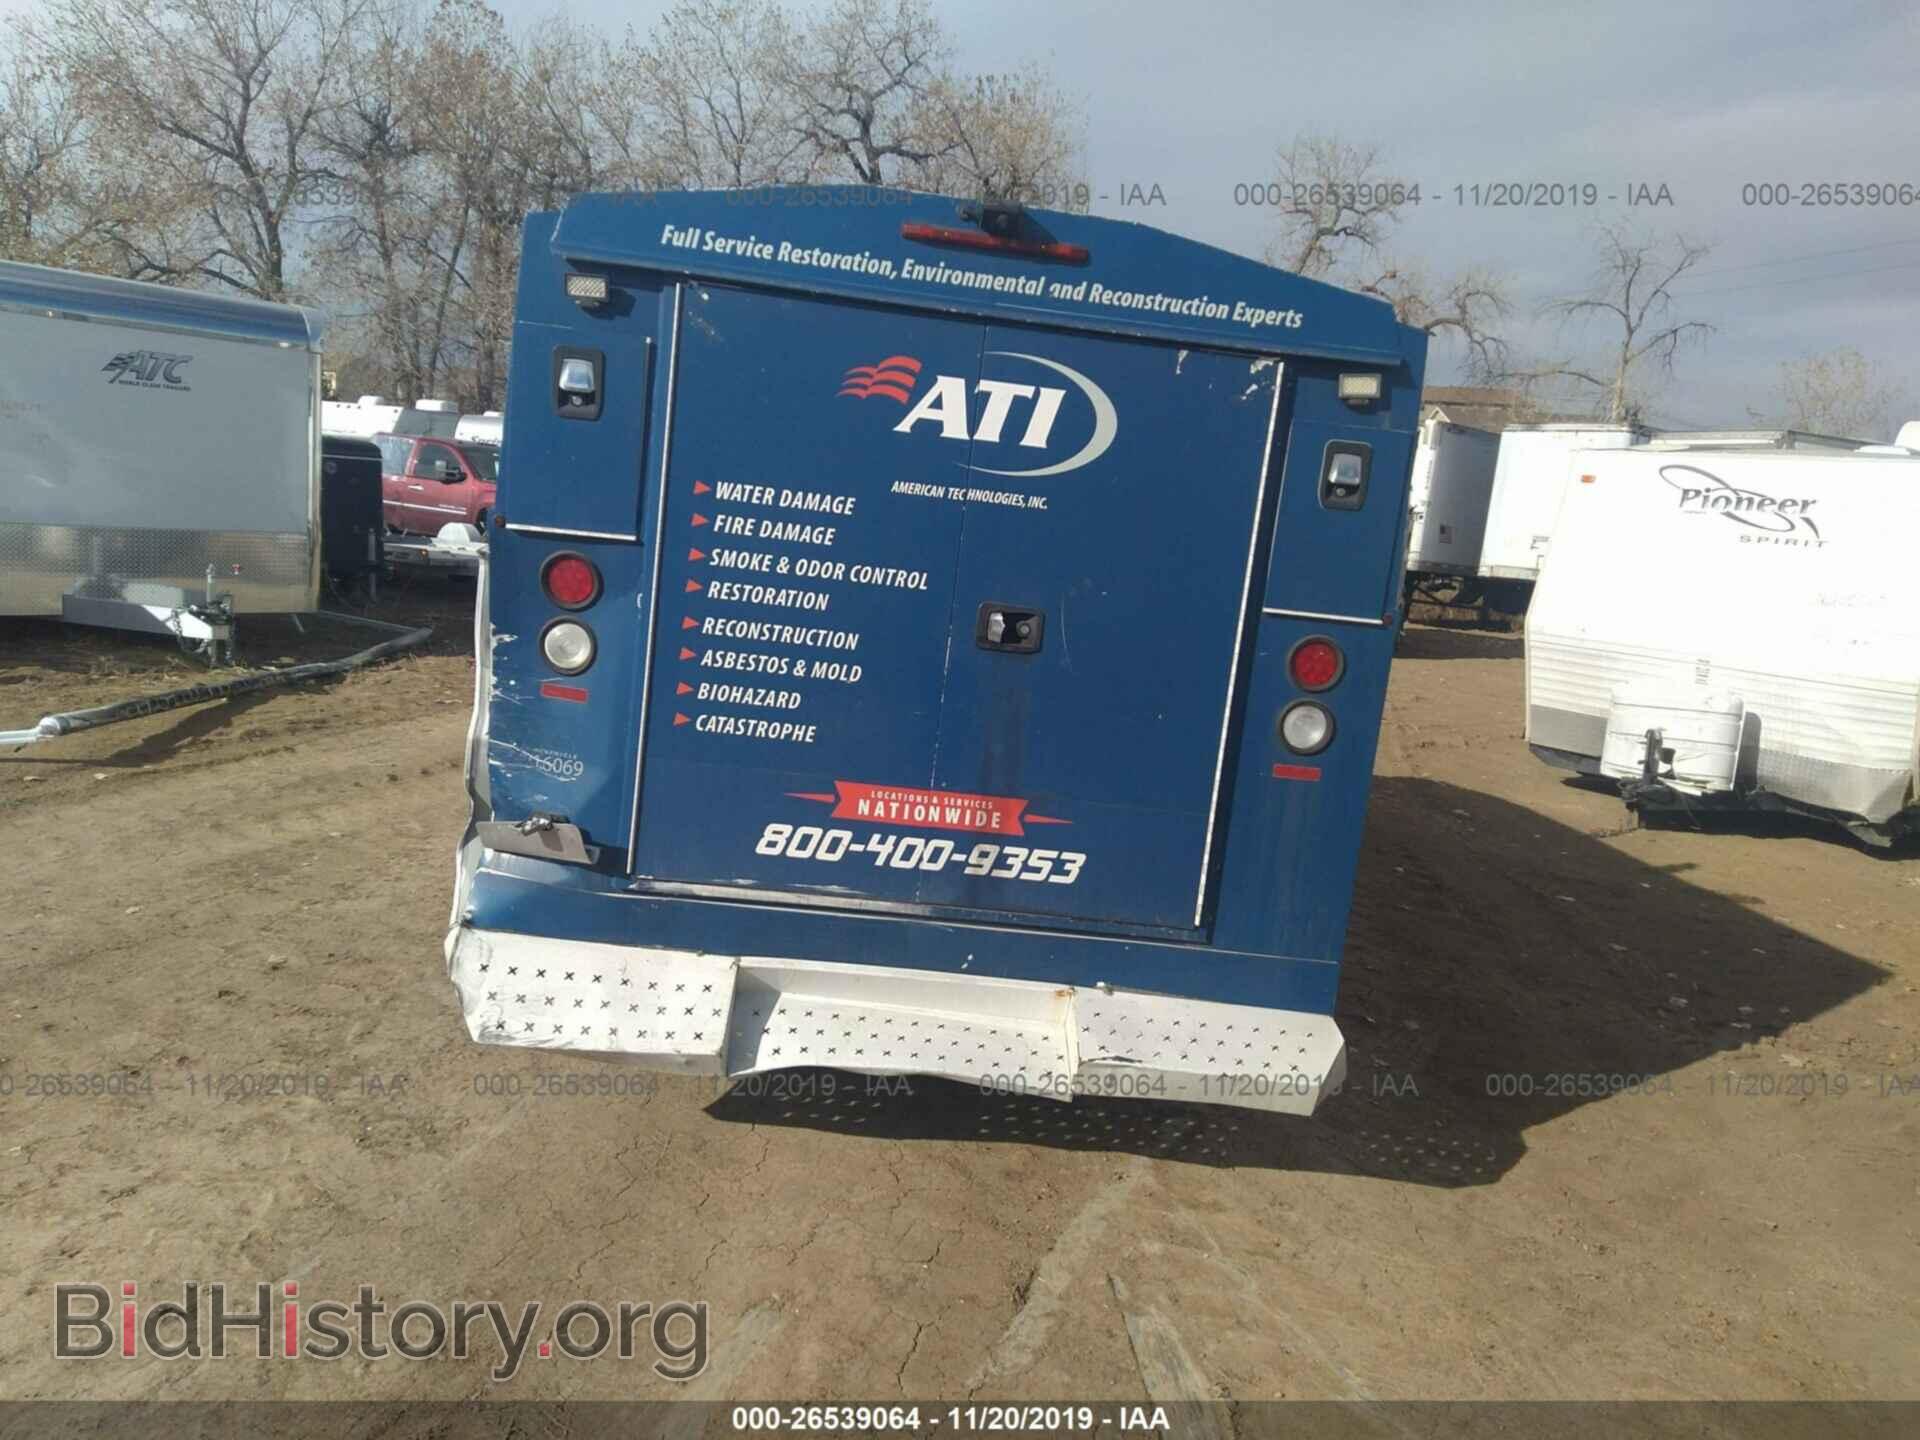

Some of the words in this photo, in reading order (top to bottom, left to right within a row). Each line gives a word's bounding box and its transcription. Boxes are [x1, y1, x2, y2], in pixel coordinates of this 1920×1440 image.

[661, 224, 701, 250] Full
[702, 230, 774, 261] Service
[777, 241, 898, 280] Restoration,
[901, 258, 1046, 297] Environmental
[1049, 281, 1088, 302] and
[1089, 284, 1229, 321] Reconstruction
[1232, 302, 1304, 328] Experts
[108, 350, 194, 384] ATC
[892, 375, 1067, 449] ATI
[715, 481, 775, 506] WATER
[779, 488, 856, 515] DAMAGE
[891, 481, 945, 499] AMERICAN
[1028, 495, 1049, 509] INC.
[1679, 487, 1818, 515] Pioneer
[713, 514, 755, 536] FIRE
[759, 520, 836, 546] DAMAGE
[1739, 535, 1829, 548] SPIRIT
[709, 548, 773, 573] SMOKE
[776, 556, 790, 575] &
[795, 558, 846, 581] ODOR
[850, 565, 929, 591] CONTROL
[707, 581, 829, 611] RESTORATION
[701, 617, 859, 651] RECONSTRUCTION
[700, 649, 789, 675] ASBESTOS
[793, 659, 807, 677] &
[811, 661, 862, 683] MOLD
[697, 682, 801, 710] BIOHAZARD
[695, 714, 816, 743] CATASTROPHE
[857, 799, 1001, 829] NATIONWIDE
[871, 790, 928, 804] LOCATIONS
[943, 797, 993, 809] SERVICES
[755, 823, 1087, 885] 800-400-9353
